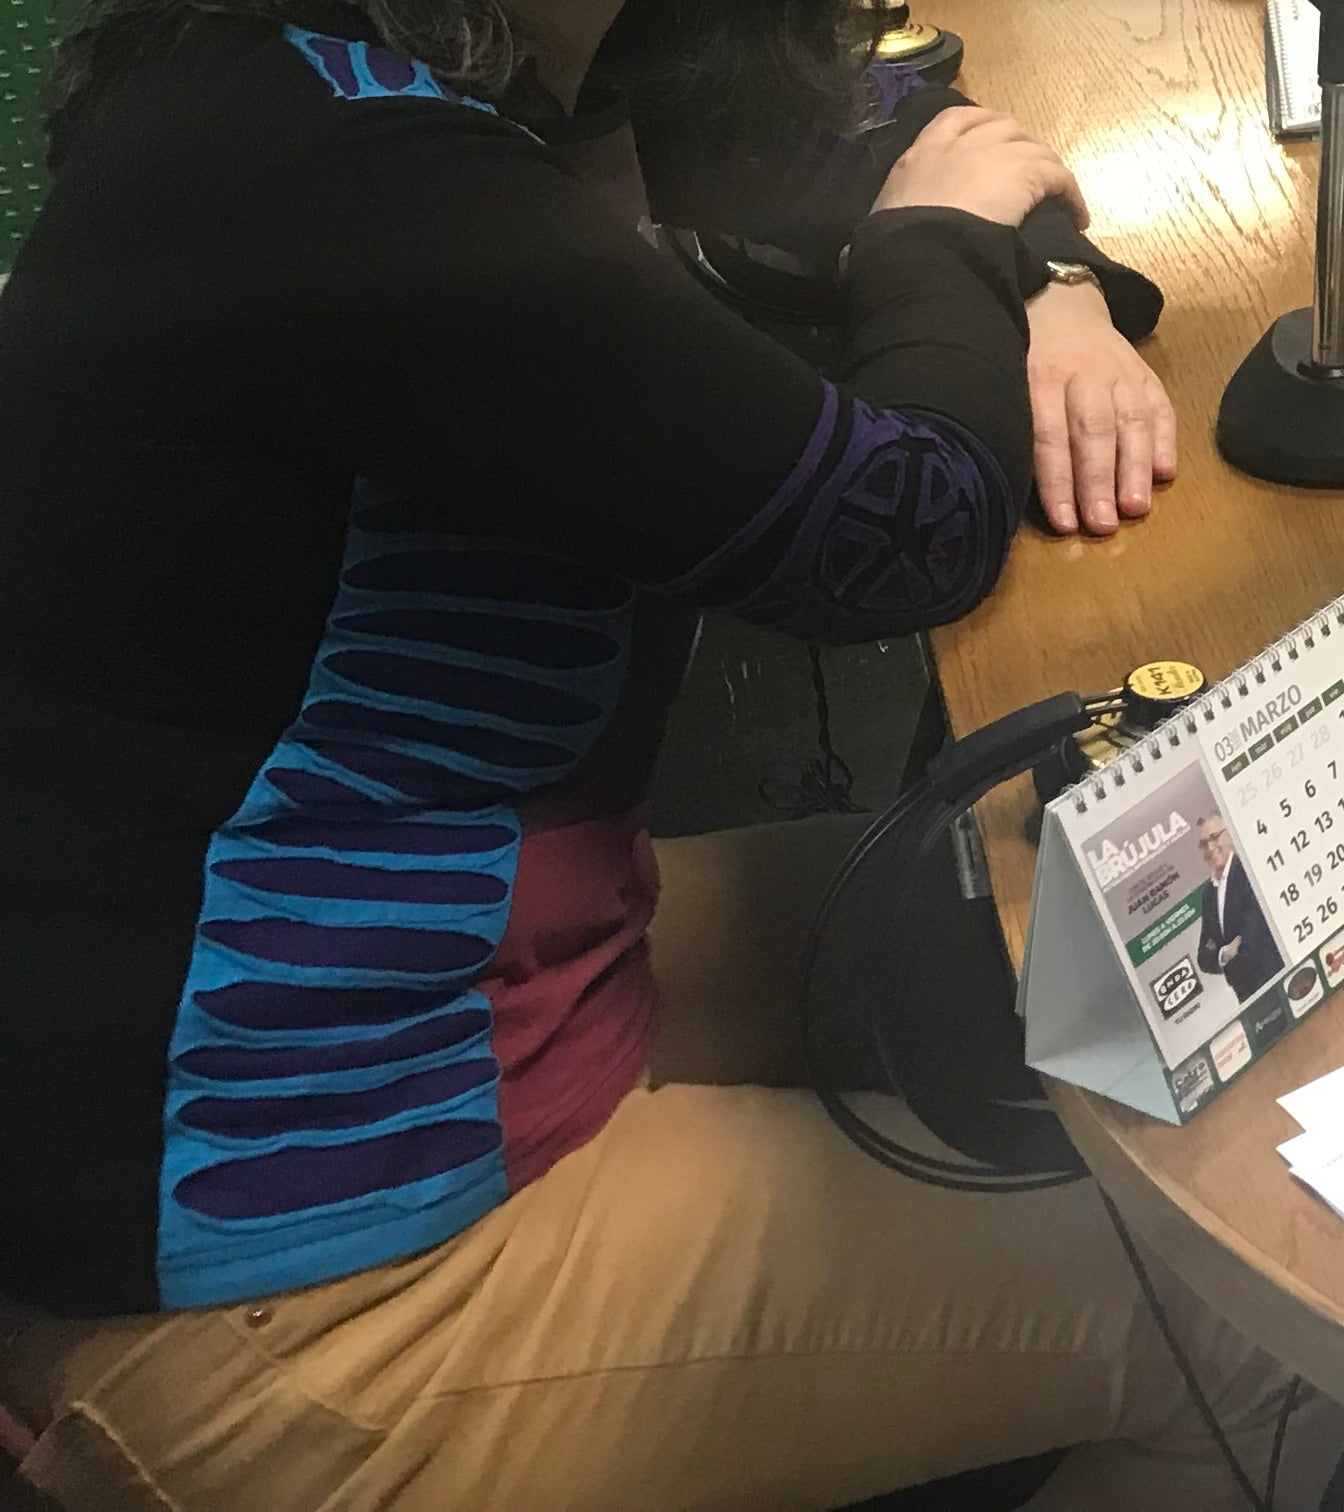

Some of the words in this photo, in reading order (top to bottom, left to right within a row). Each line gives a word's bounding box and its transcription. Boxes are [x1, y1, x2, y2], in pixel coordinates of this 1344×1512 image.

[1214, 736, 1234, 762] 03
[1239, 684, 1302, 742] MARZO
[1257, 820, 1267, 834] 4
[1280, 799, 1291, 817] 5
[1305, 780, 1316, 798] 6
[1328, 761, 1336, 779] 7
[1087, 839, 1119, 870] LA
[1094, 811, 1189, 886] BRÚJULA
[1267, 850, 1284, 871] 11
[1291, 830, 1309, 852] 12
[1315, 811, 1333, 833] 13
[1142, 890, 1170, 915] LUCAS
[1280, 883, 1299, 906] 18
[1304, 864, 1322, 886] 19
[1294, 917, 1313, 943] 25
[1317, 897, 1337, 923] 26
[1159, 967, 1189, 993] ONDA
[1166, 980, 1195, 1006] CERO
